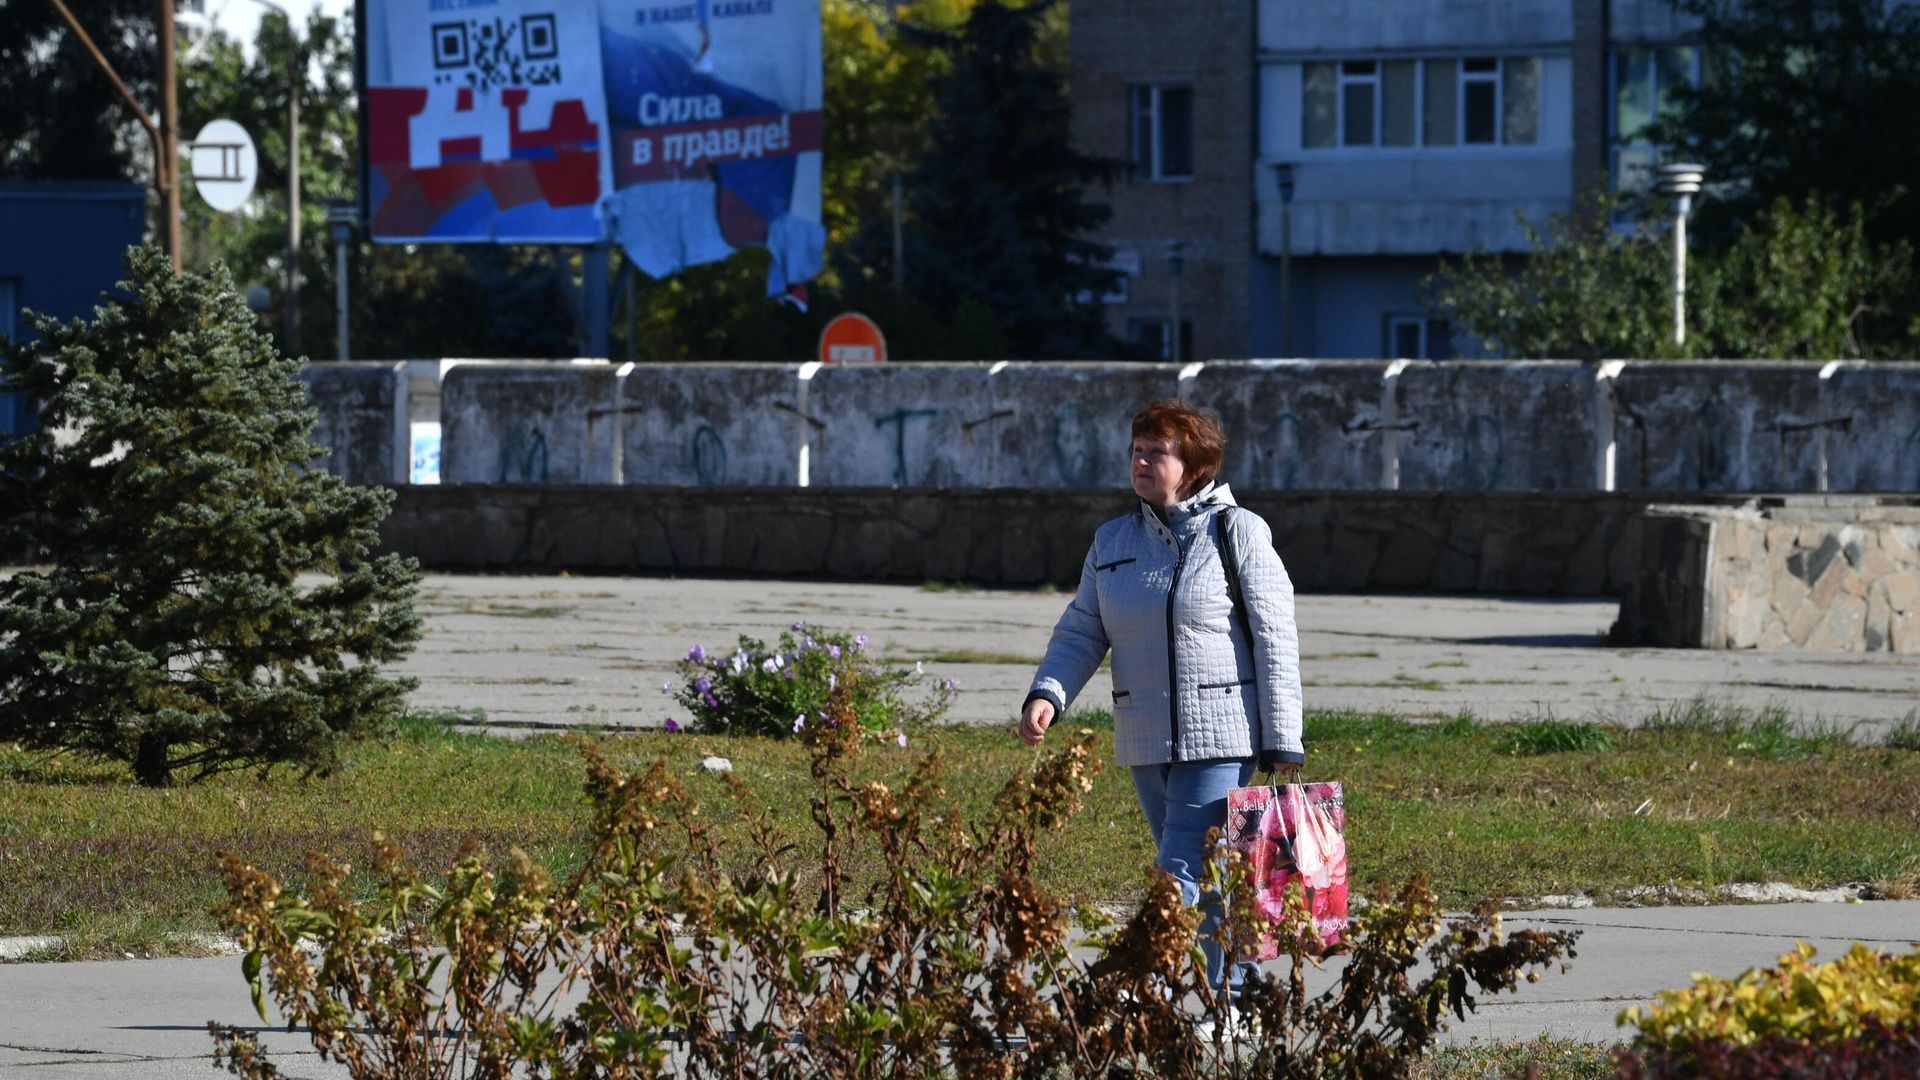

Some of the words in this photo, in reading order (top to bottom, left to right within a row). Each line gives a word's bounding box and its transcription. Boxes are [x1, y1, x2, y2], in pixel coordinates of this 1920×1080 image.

[634, 8, 647, 26] В
[650, 5, 694, 24] НАШЕ
[638, 92, 723, 126] Сила
[632, 137, 653, 166] в
[662, 112, 790, 168] правде!
[1243, 798, 1265, 812] Bella
[1323, 918, 1349, 930] ROSA
